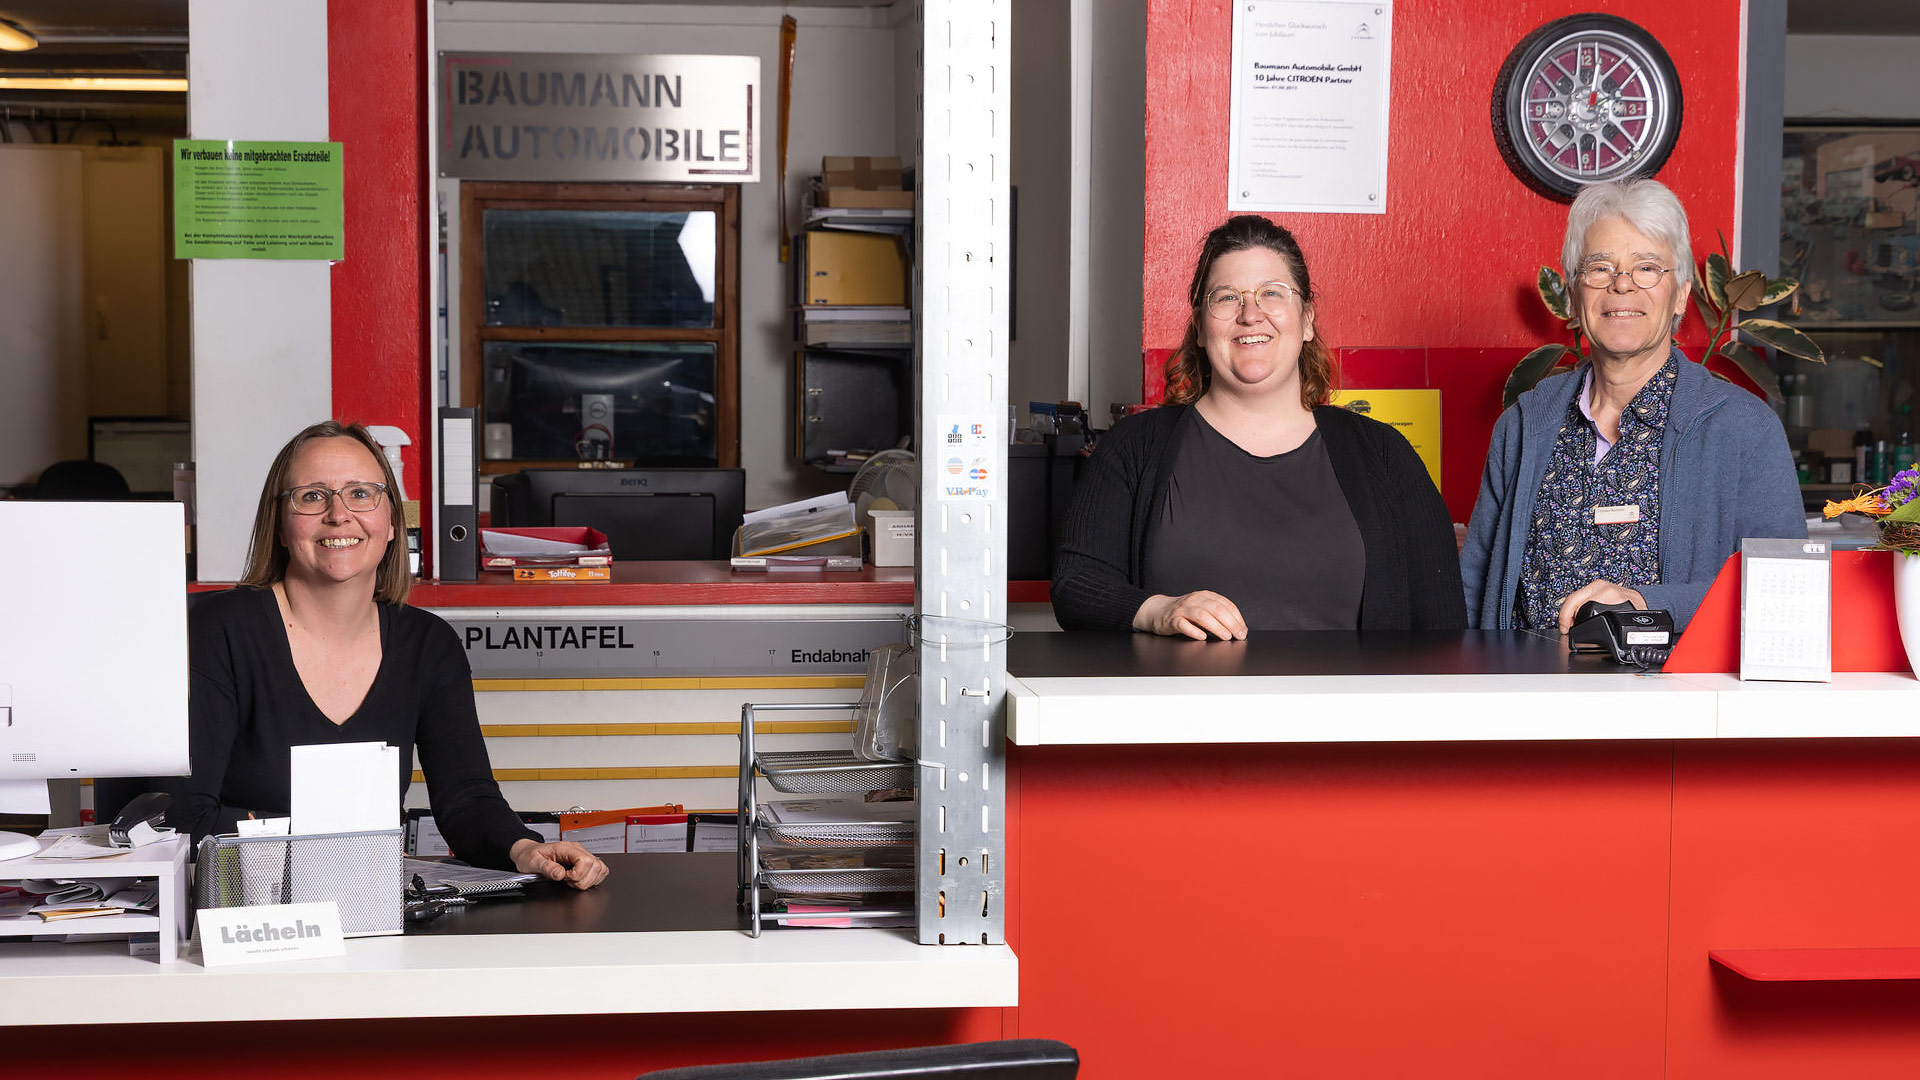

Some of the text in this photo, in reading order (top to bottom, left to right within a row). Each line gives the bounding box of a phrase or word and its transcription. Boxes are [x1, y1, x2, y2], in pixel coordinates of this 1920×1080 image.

[1581, 54, 1592, 66] 12
[1254, 62, 1362, 72] Baumann Automobile GmbH
[1254, 74, 1265, 82] 10
[1266, 74, 1285, 83] Jahre
[1325, 76, 1353, 84] Partner
[457, 70, 683, 108] BAUMANN
[1535, 105, 1543, 115] 9
[1628, 104, 1637, 114] 3
[459, 125, 742, 162] AUTOMOBILE
[180, 148, 192, 161] Wir
[193, 148, 223, 162] verbauen
[243, 149, 292, 165] mitgebrachten
[293, 150, 331, 163] Ersatzteile!
[1582, 153, 1590, 165] 6
[465, 625, 634, 650] PLANTAFEL
[791, 649, 870, 664] Endabnah
[220, 919, 322, 944] Lächeln
